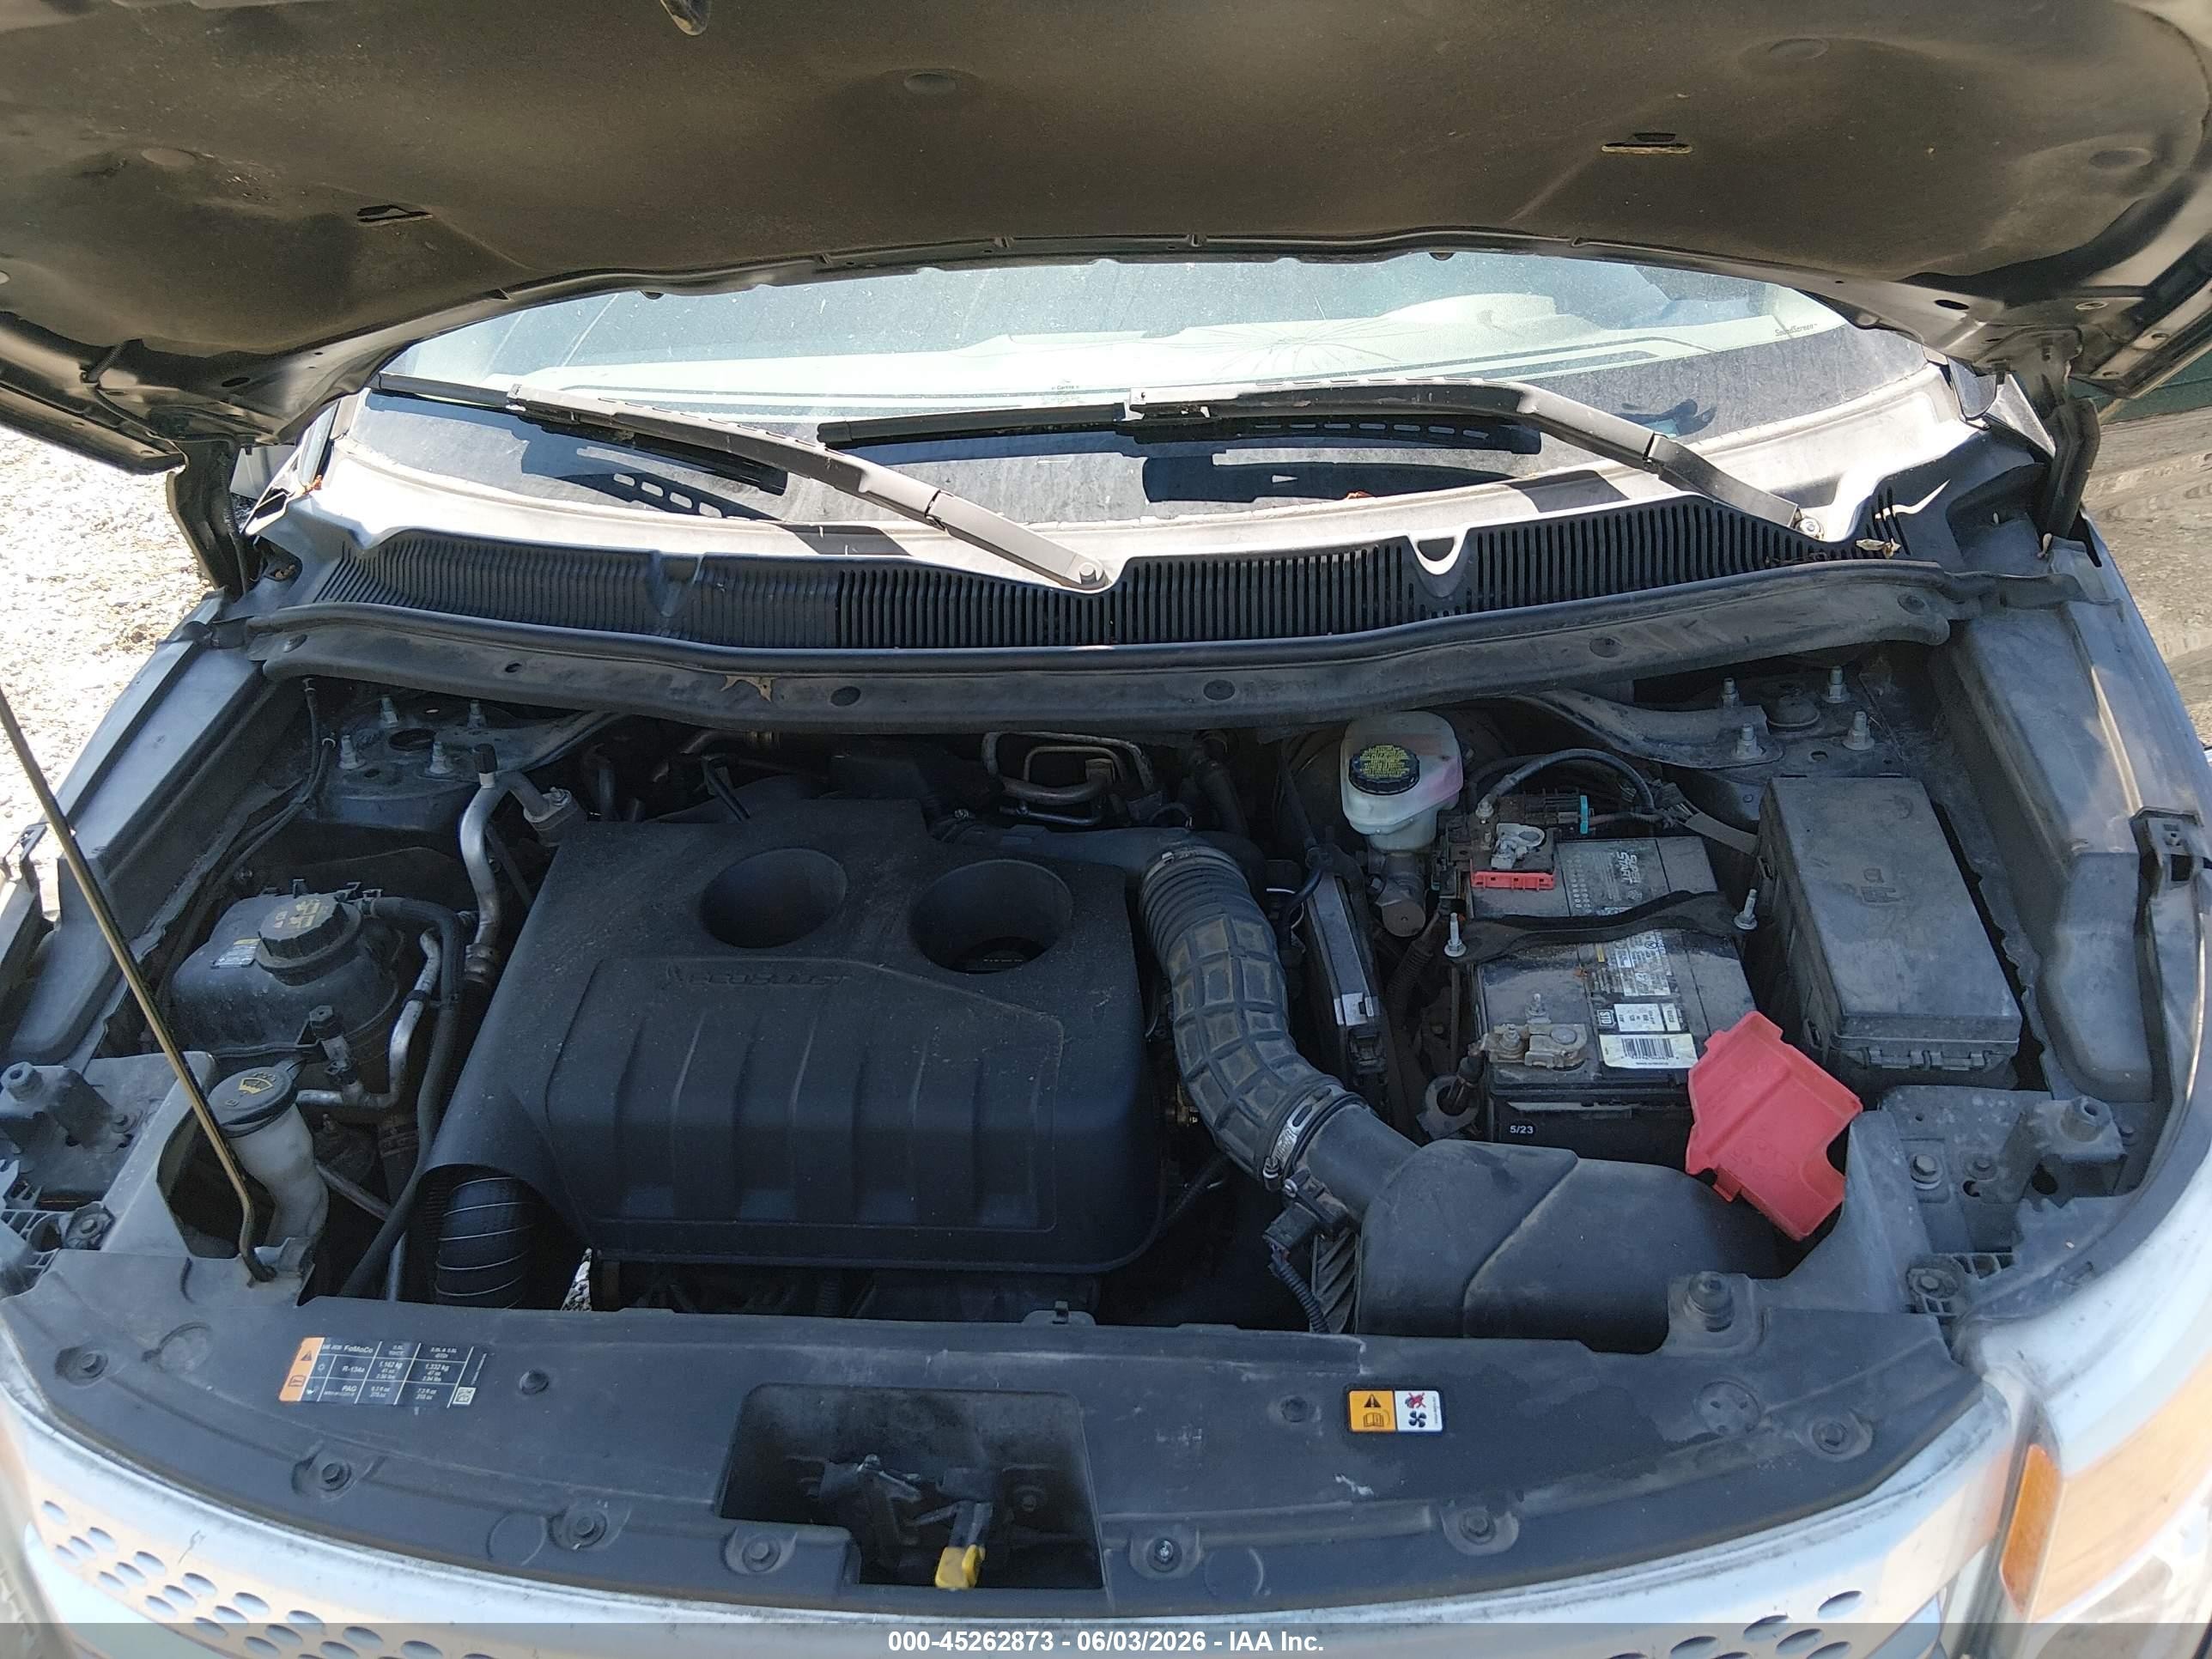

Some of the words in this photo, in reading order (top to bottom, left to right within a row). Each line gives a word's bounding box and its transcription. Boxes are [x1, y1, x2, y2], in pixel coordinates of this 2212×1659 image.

[1616, 851, 1633, 884] START
[1510, 1125, 1534, 1134] 5/23
[343, 1345, 374, 1354] FoMoCo
